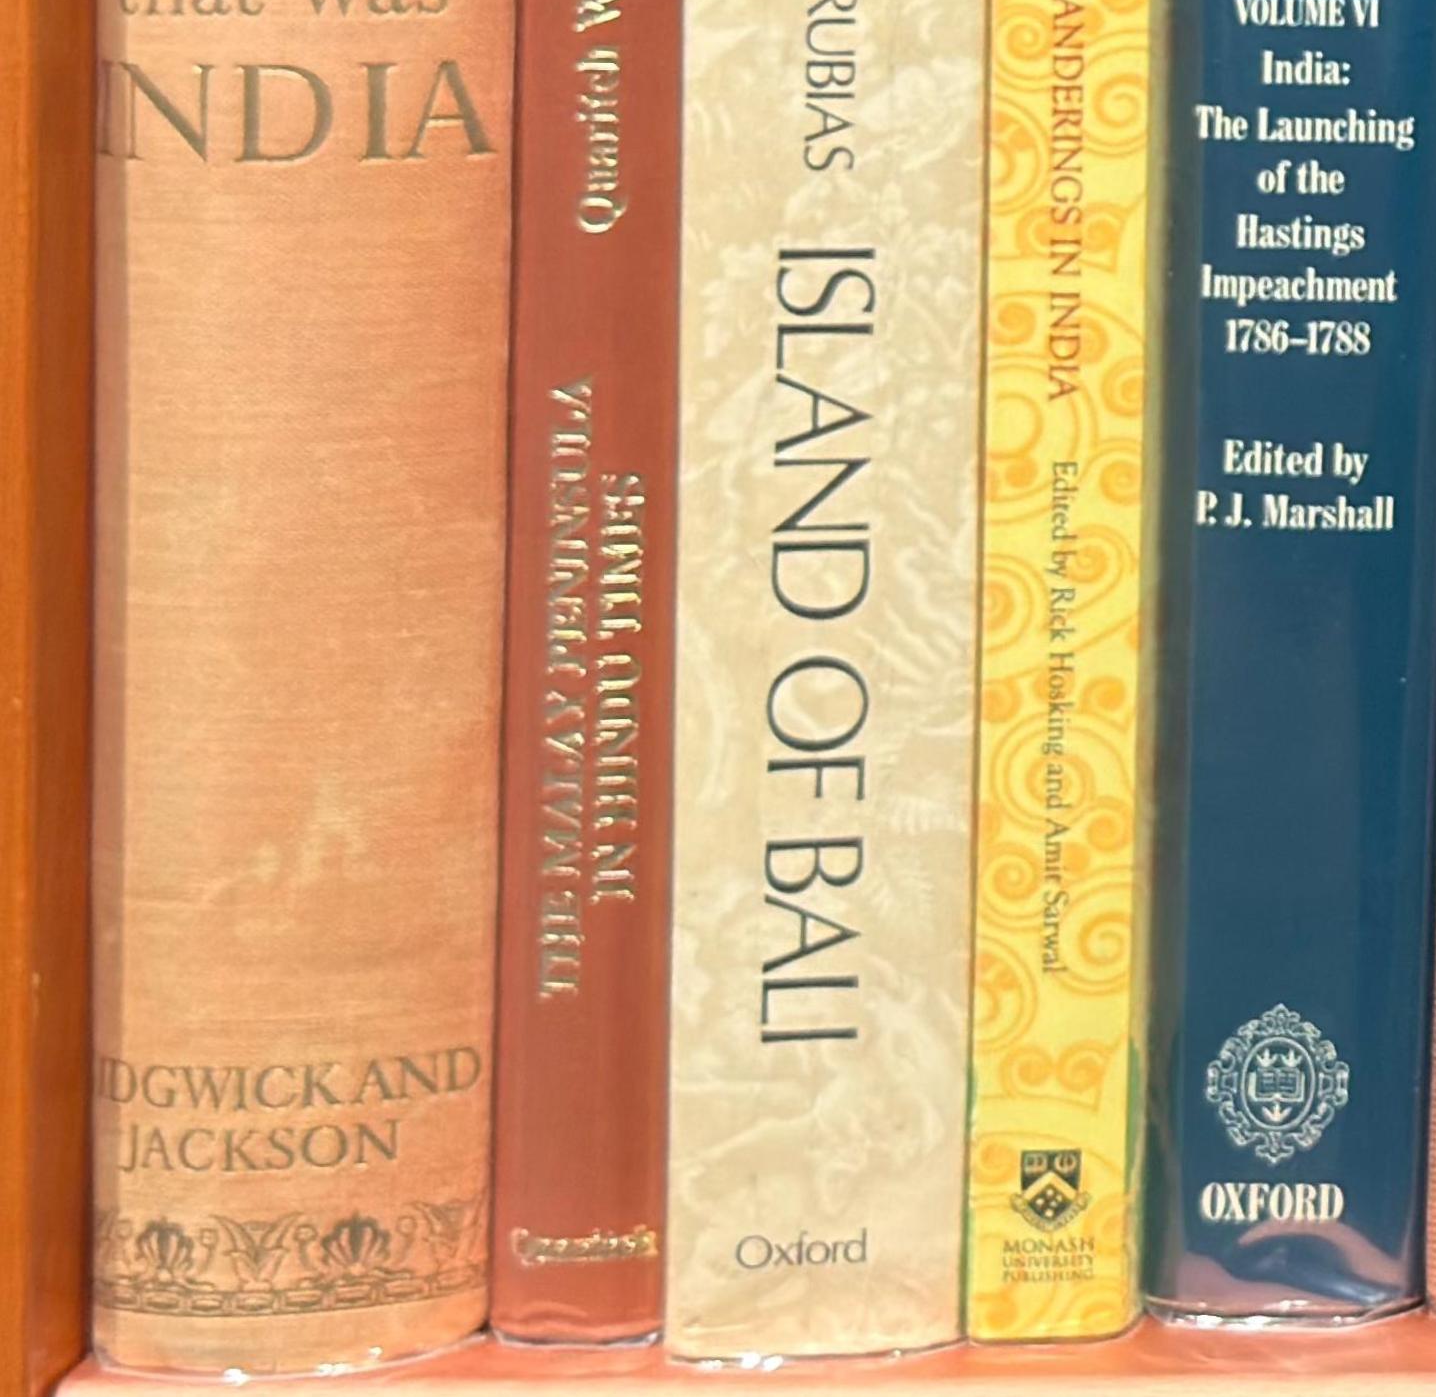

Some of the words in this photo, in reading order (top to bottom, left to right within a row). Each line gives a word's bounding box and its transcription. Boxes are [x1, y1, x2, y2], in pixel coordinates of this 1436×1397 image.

[1261, 49, 1352, 87] India:
[97, 59, 499, 165] INDIA
[573, 45, 628, 235] Quaritch
[1195, 104, 1249, 142] The
[1257, 107, 1416, 151] Launching
[1257, 159, 1292, 194] of
[1297, 160, 1346, 196] the
[1048, 237, 1083, 279] IN
[1235, 213, 1366, 257] Hastings
[1201, 263, 1399, 308] Impeachment
[1046, 292, 1083, 402] INDIA
[770, 248, 876, 621] ISLAND
[1223, 438, 1324, 478] Edited
[1332, 442, 1370, 486] by
[546, 374, 593, 678] PENINSULA
[1050, 460, 1079, 542] Edited
[1195, 489, 1218, 526] P.
[1223, 492, 1253, 528] J.
[1261, 493, 1395, 531] Marshall
[597, 470, 646, 639] TIMES
[1044, 548, 1078, 579] by
[1049, 587, 1077, 644] Rick
[766, 654, 870, 802] OF
[1042, 651, 1076, 757] Hosking
[540, 689, 587, 877] MALAY
[1045, 762, 1074, 810] and
[1043, 818, 1071, 888] Amir
[540, 890, 584, 1000] THE
[760, 835, 864, 1045] BALI
[1041, 889, 1070, 974] Sarwal
[98, 1055, 343, 1111] IDGWICK
[355, 1046, 482, 1105] AND
[119, 1118, 400, 1175] JACKSON
[1200, 1181, 1346, 1222] OXFORD
[735, 1227, 868, 1271] Oxford
[1002, 1236, 1095, 1253] MONASH
